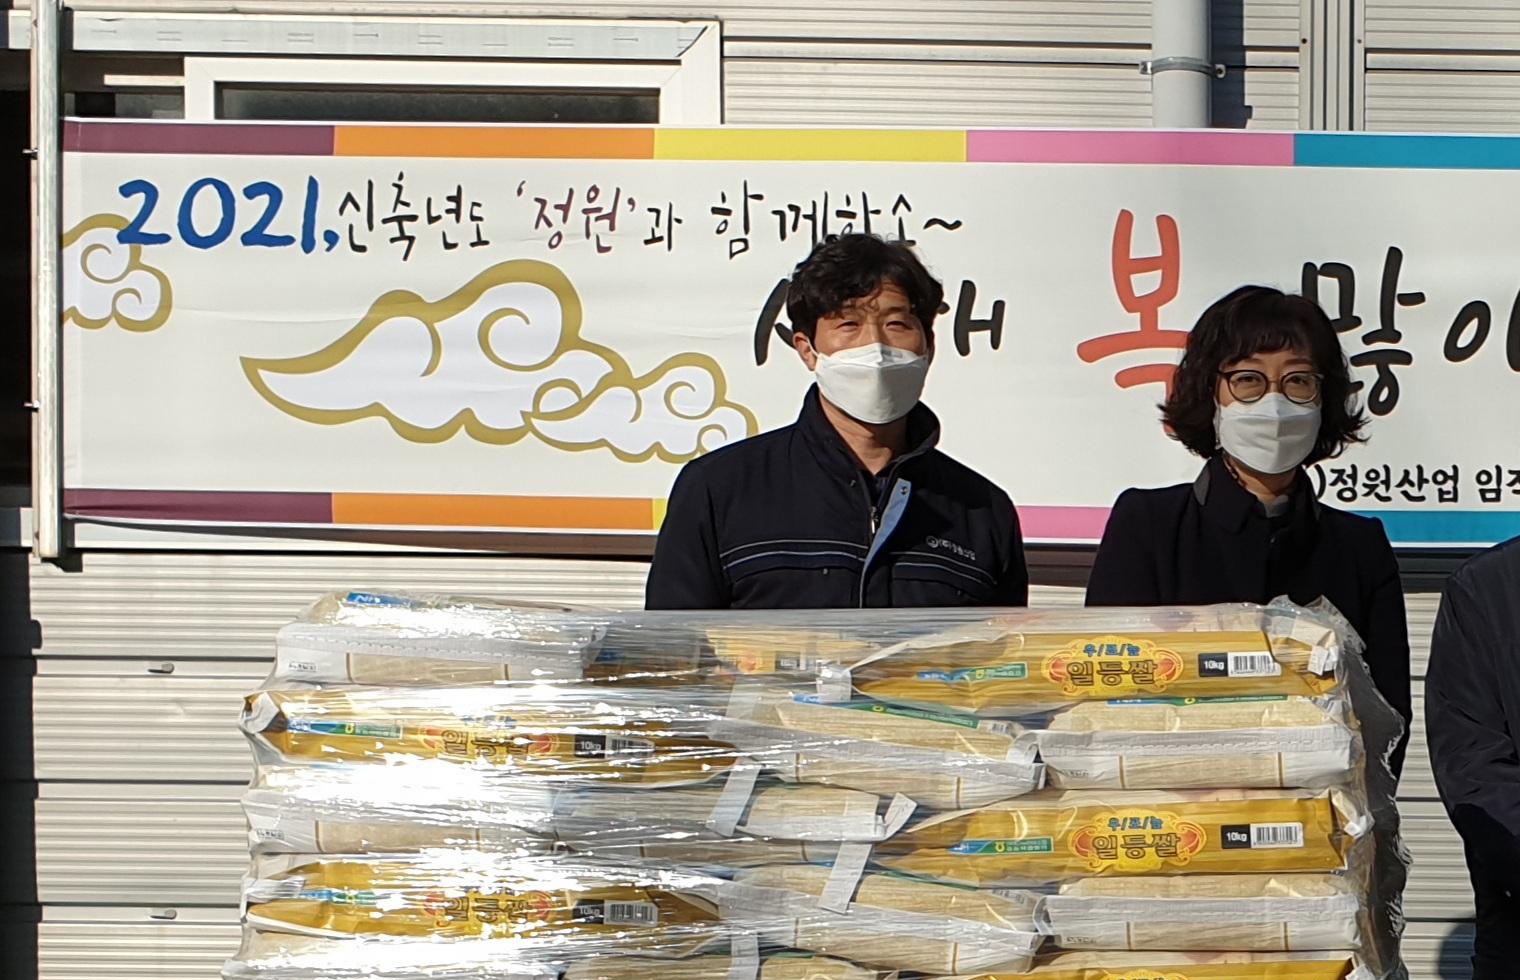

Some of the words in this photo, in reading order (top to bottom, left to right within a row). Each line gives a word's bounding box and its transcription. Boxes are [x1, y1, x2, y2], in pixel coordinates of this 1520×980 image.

[1303, 464, 1460, 504] )정원산업
[1066, 659, 1159, 686] 일등쌀
[1092, 833, 1181, 860] 일등쌀
